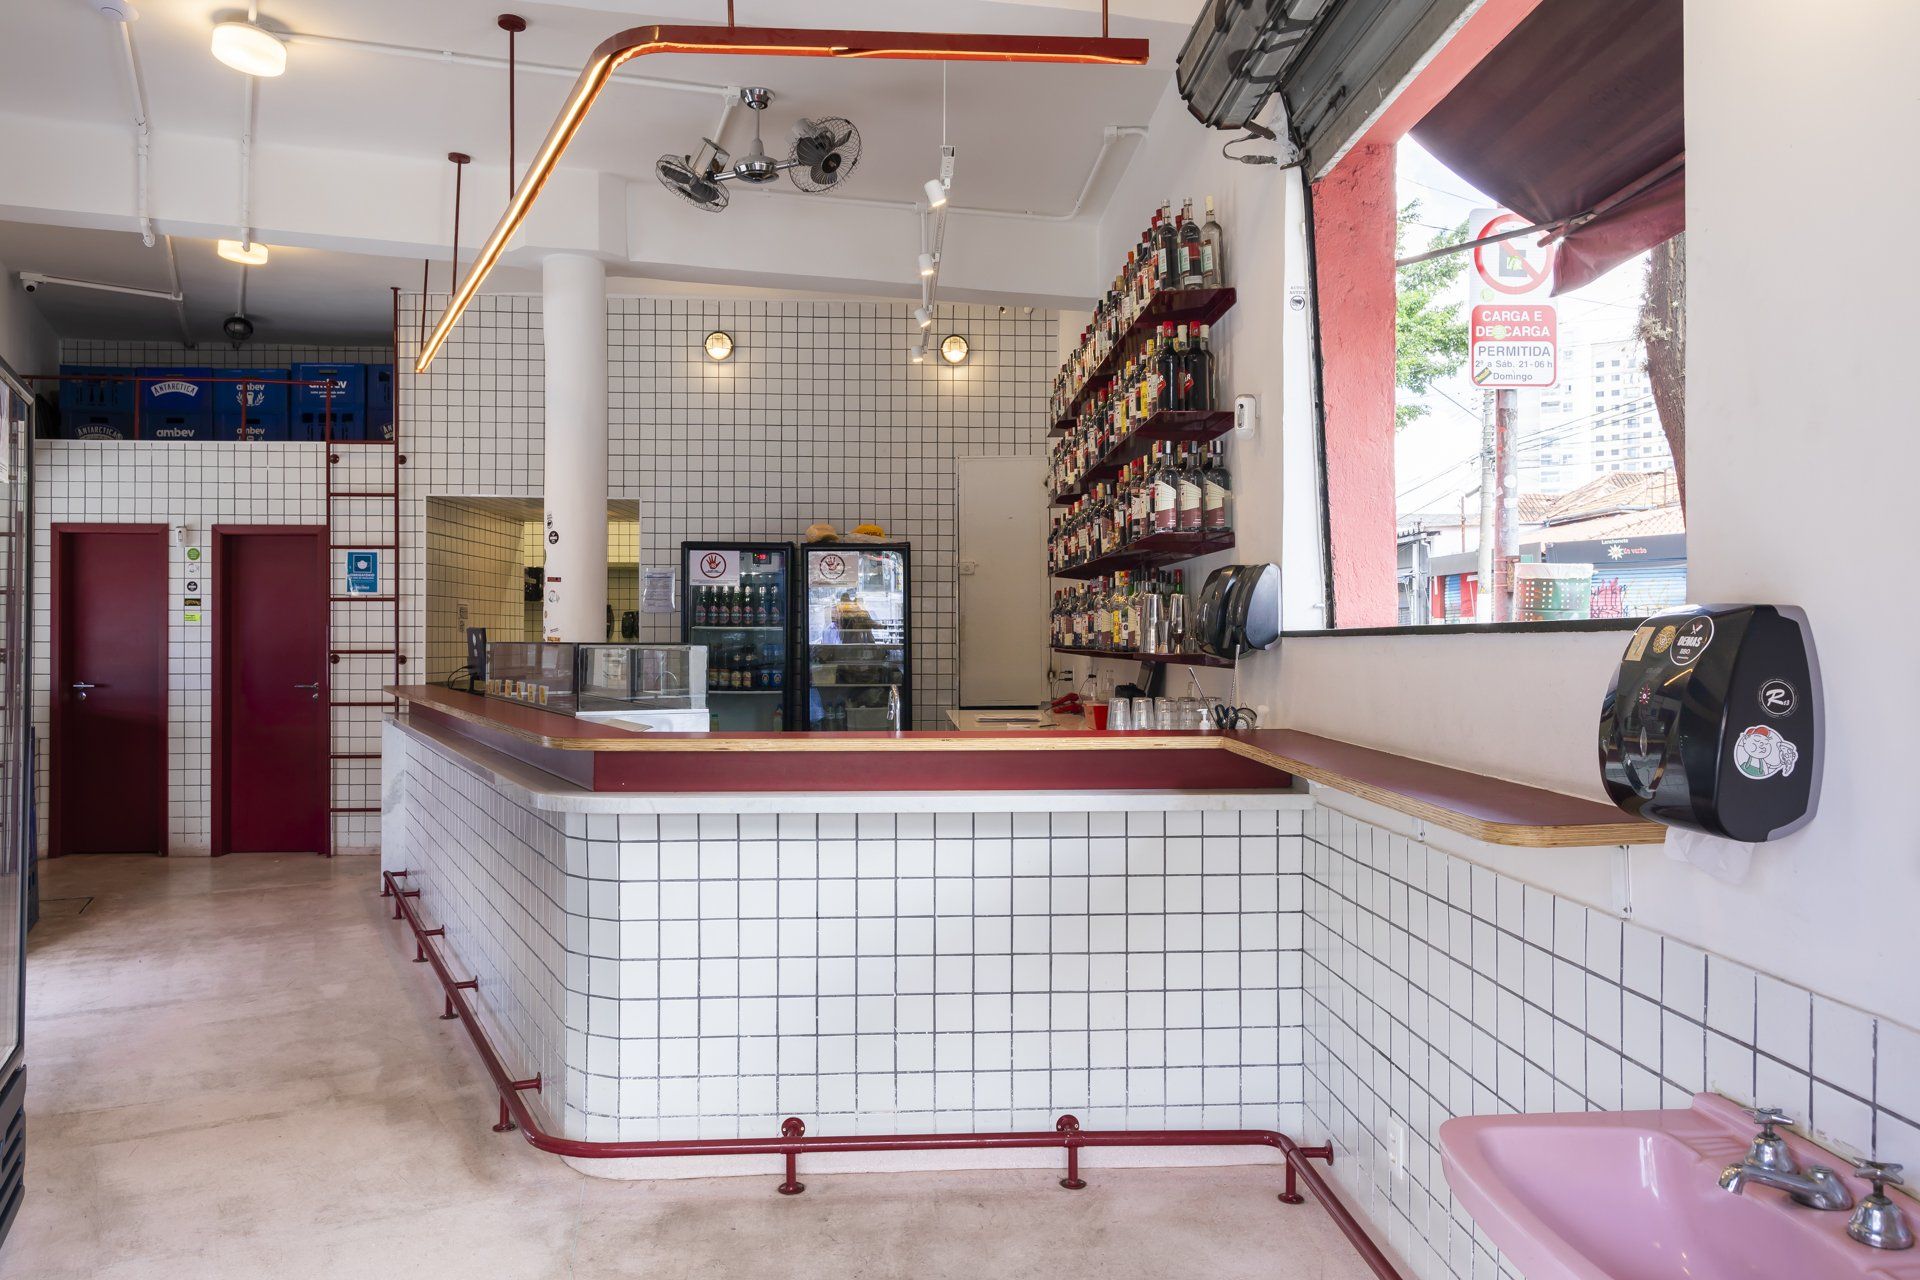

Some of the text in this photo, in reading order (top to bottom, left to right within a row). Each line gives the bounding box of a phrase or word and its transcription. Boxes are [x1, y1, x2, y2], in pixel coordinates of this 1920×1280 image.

[1482, 310, 1543, 322] CARGA E
[1475, 325, 1551, 337] DECARGA
[1478, 346, 1551, 357] PERMITIDA
[1547, 360, 1553, 368] h
[1493, 373, 1533, 382] Domingo
[152, 382, 197, 396] ANTARCTICA
[77, 426, 119, 437] ANTARCTICA
[156, 427, 195, 438] ambev
